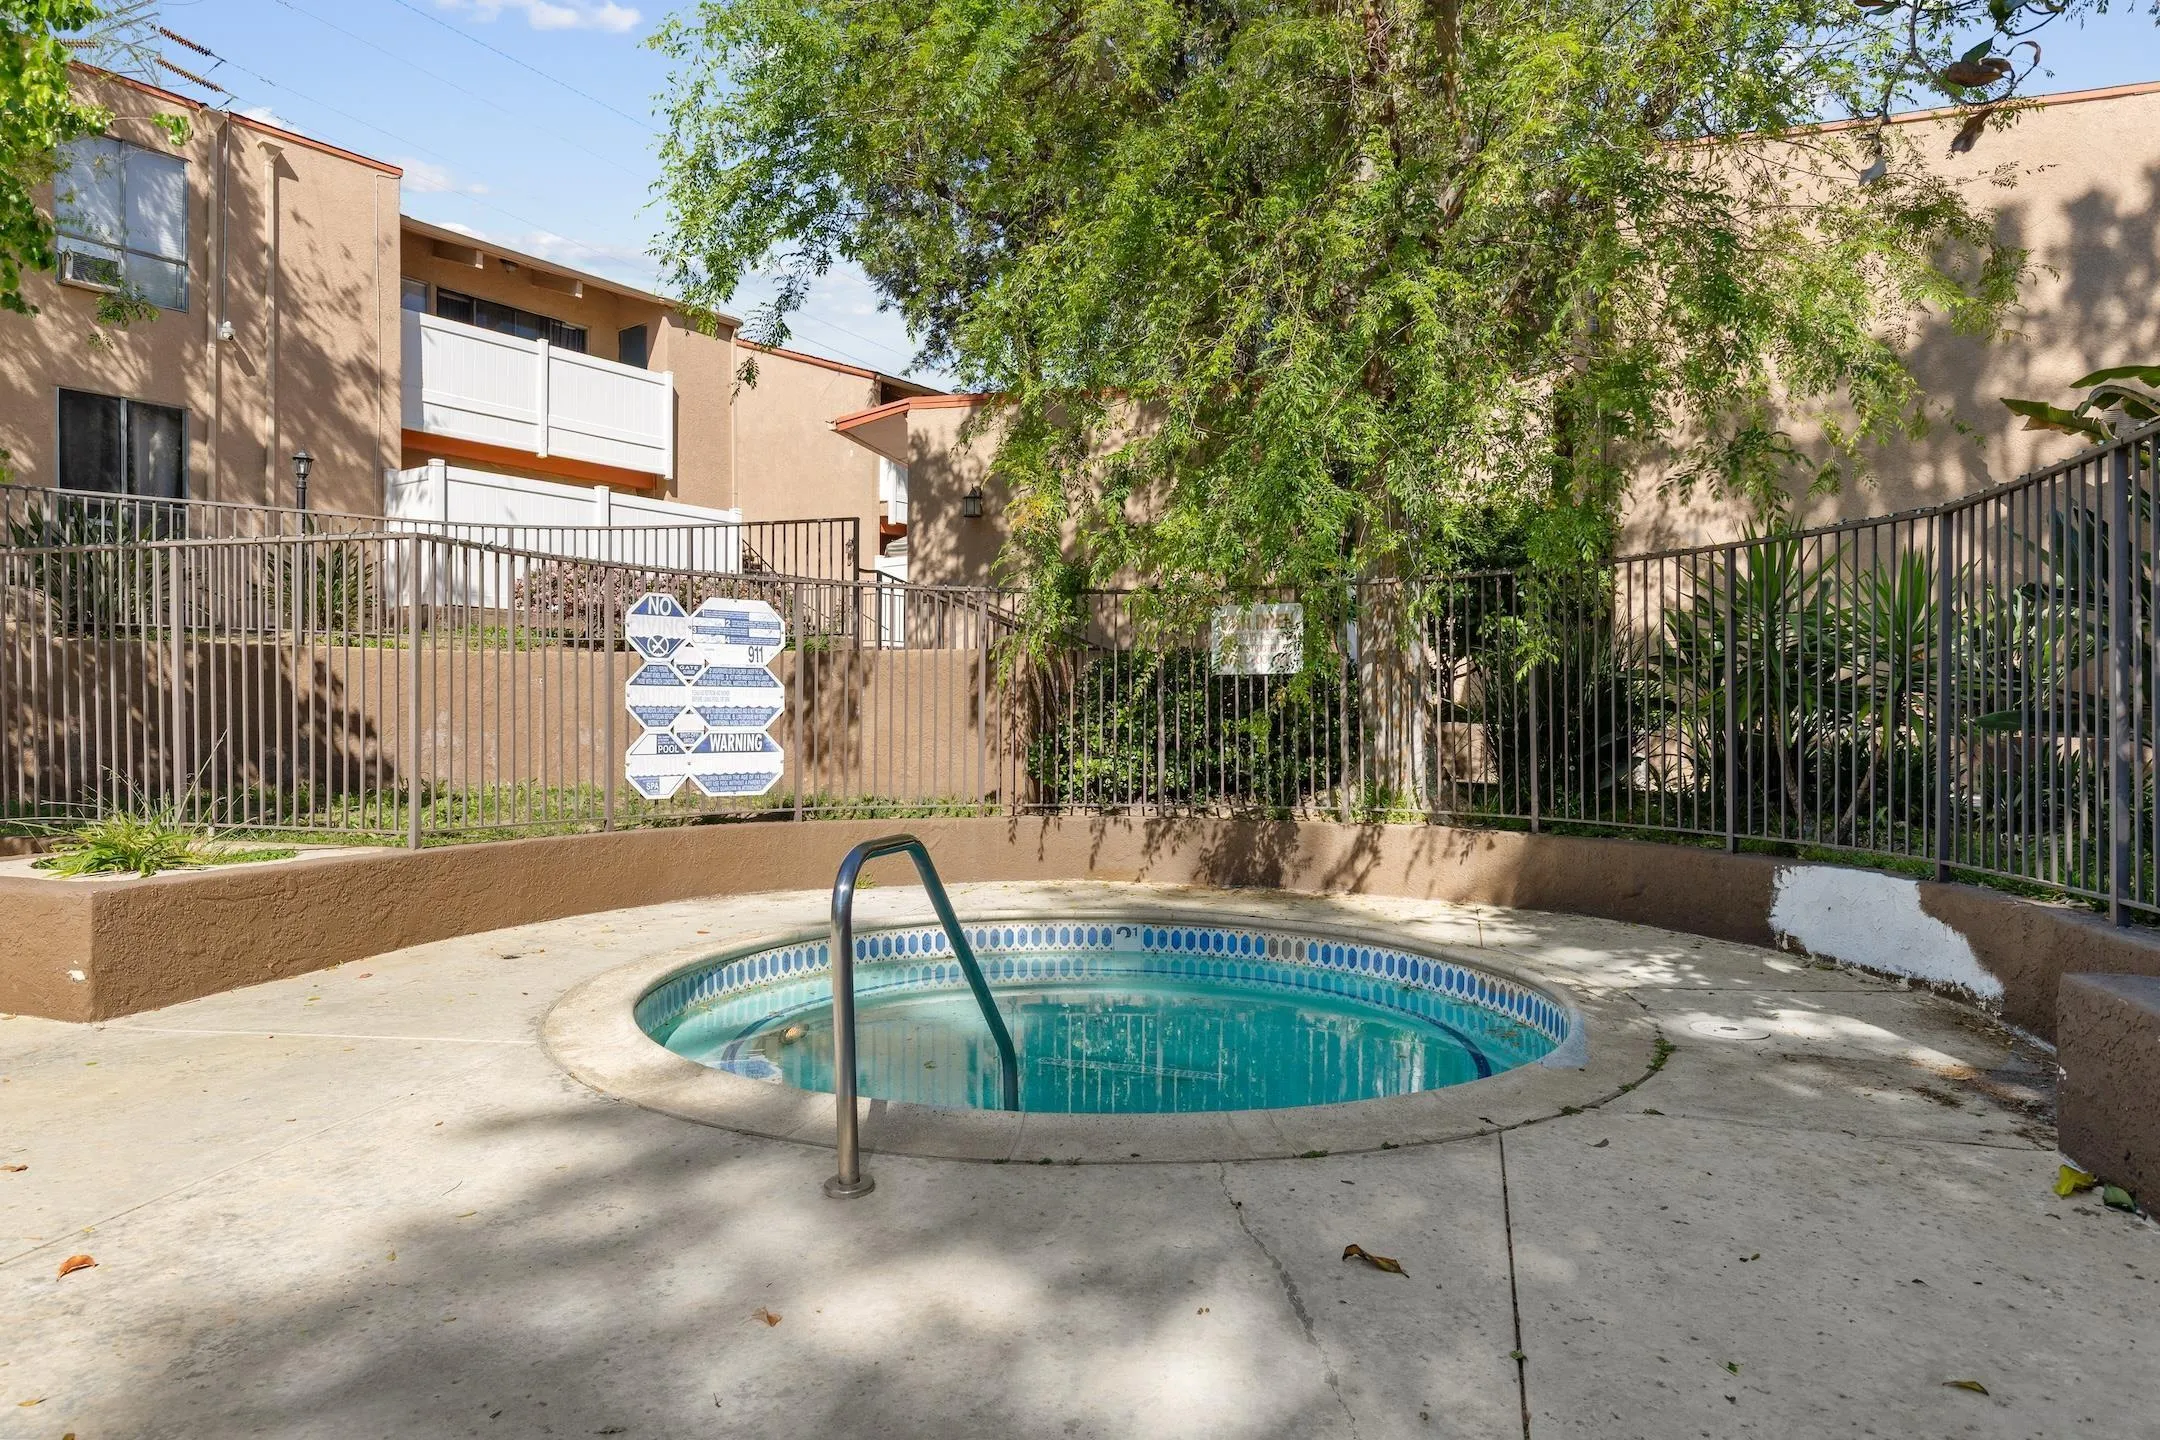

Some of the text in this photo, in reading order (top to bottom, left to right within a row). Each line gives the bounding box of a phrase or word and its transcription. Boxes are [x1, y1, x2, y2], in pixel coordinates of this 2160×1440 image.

[648, 596, 672, 616] NO
[725, 619, 731, 628] 2
[692, 626, 697, 634] 3
[748, 645, 764, 664] 911
[709, 733, 763, 752] WARNING
[657, 744, 680, 754] POOL
[646, 782, 659, 790] SPA
